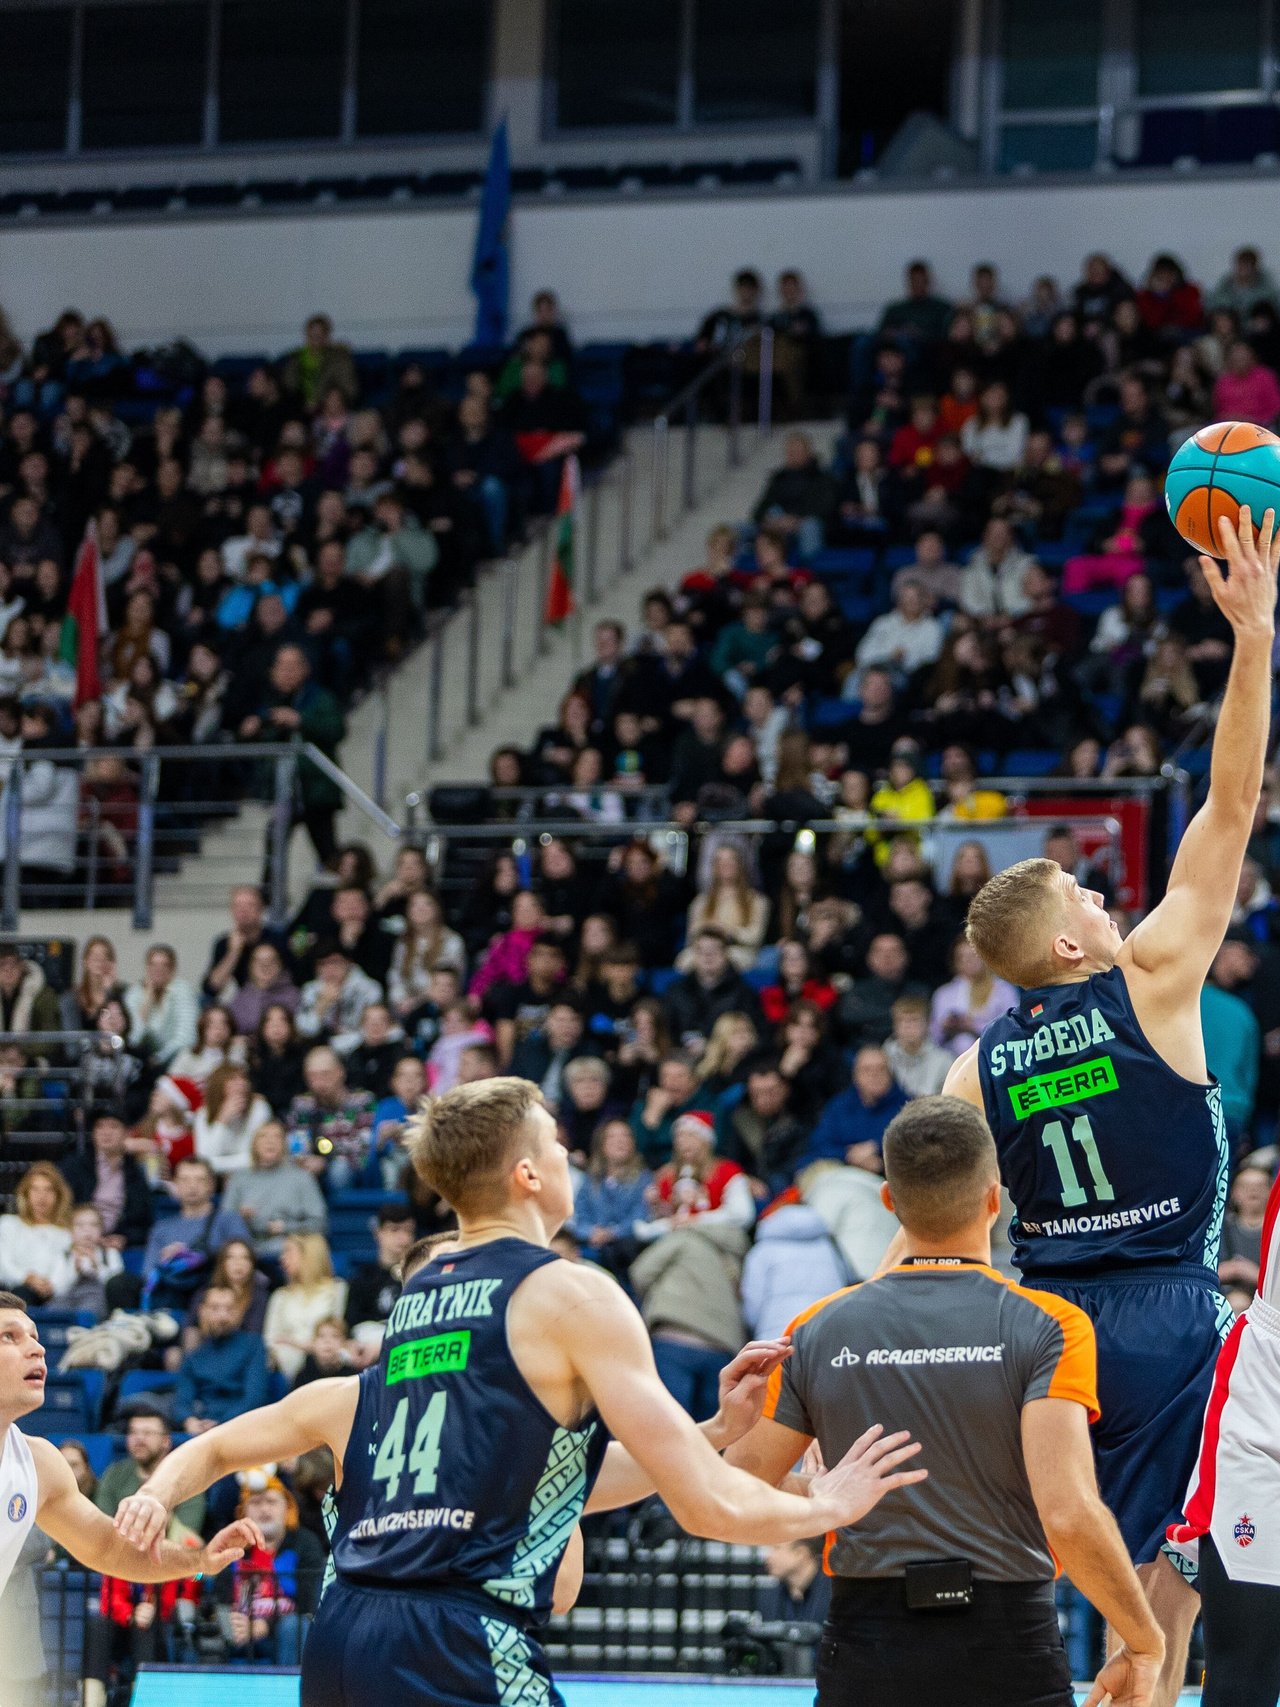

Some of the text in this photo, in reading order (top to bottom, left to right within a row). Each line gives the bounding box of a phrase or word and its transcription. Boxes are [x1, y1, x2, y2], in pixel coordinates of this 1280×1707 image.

[1041, 1114, 1115, 1207] 11
[390, 1341, 463, 1376] BETERA
[372, 1390, 447, 1502] 44
[1234, 1526, 1254, 1535] CSKA
